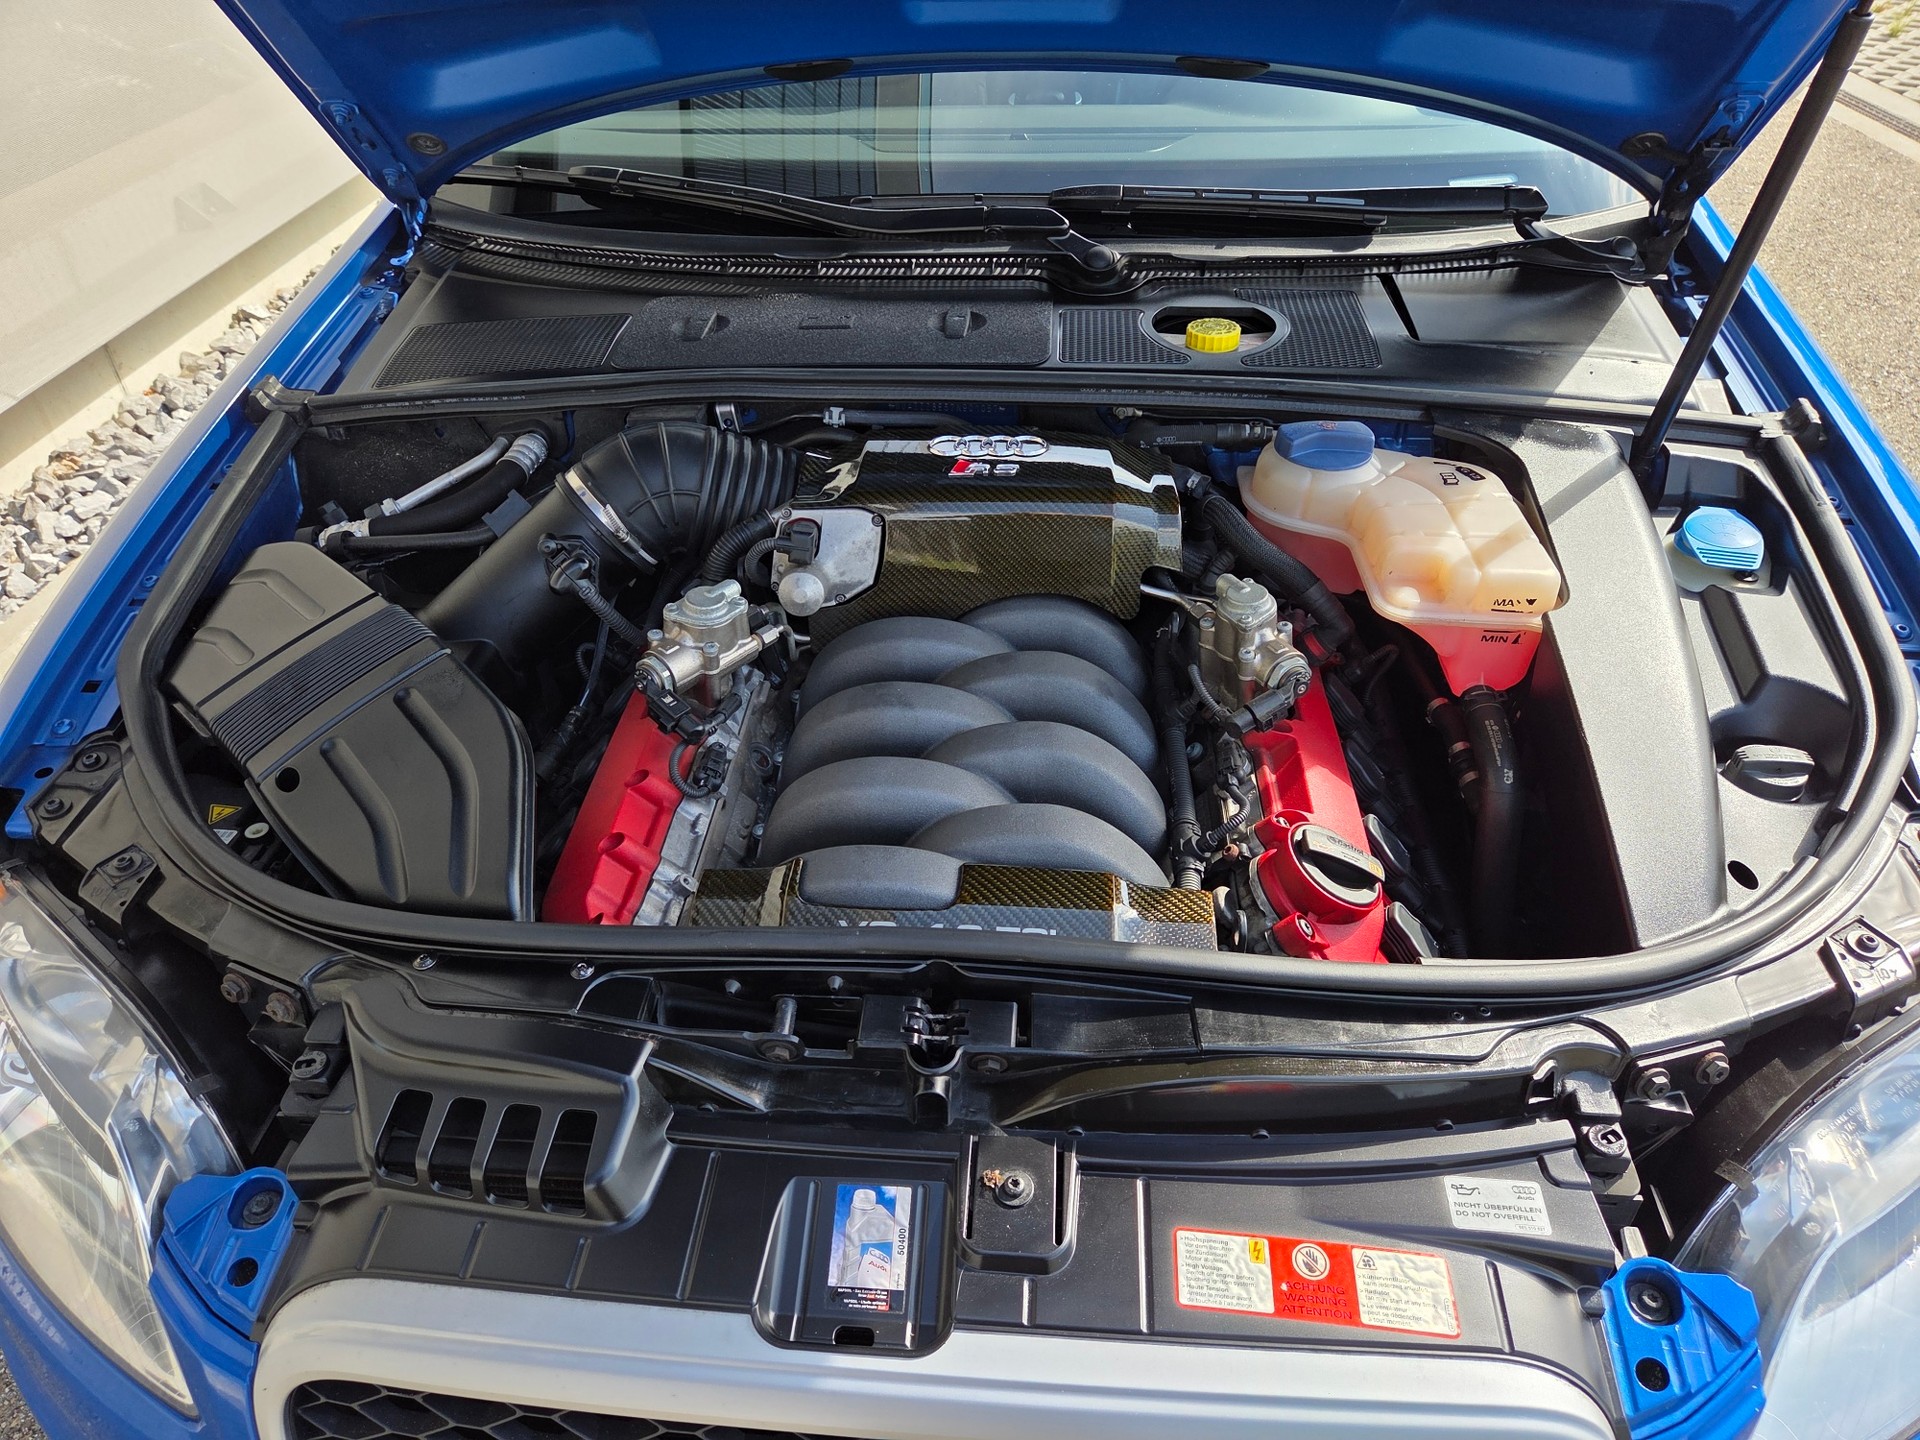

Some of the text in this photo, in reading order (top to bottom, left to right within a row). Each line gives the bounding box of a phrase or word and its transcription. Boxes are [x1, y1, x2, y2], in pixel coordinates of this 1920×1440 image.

[1493, 598, 1521, 606] MA
[1480, 634, 1509, 643] MIN
[1484, 1202, 1542, 1213] ÜBERFÜLLEN
[1493, 1213, 1536, 1221] OVERFILL
[897, 1228, 907, 1256] 50400
[1184, 1236, 1229, 1246] Hochspannung
[868, 1260, 888, 1273] Audi
[1286, 1281, 1345, 1294] ACHTUNG
[1284, 1293, 1347, 1306] WARNING
[1282, 1304, 1352, 1319] ATTENTION
